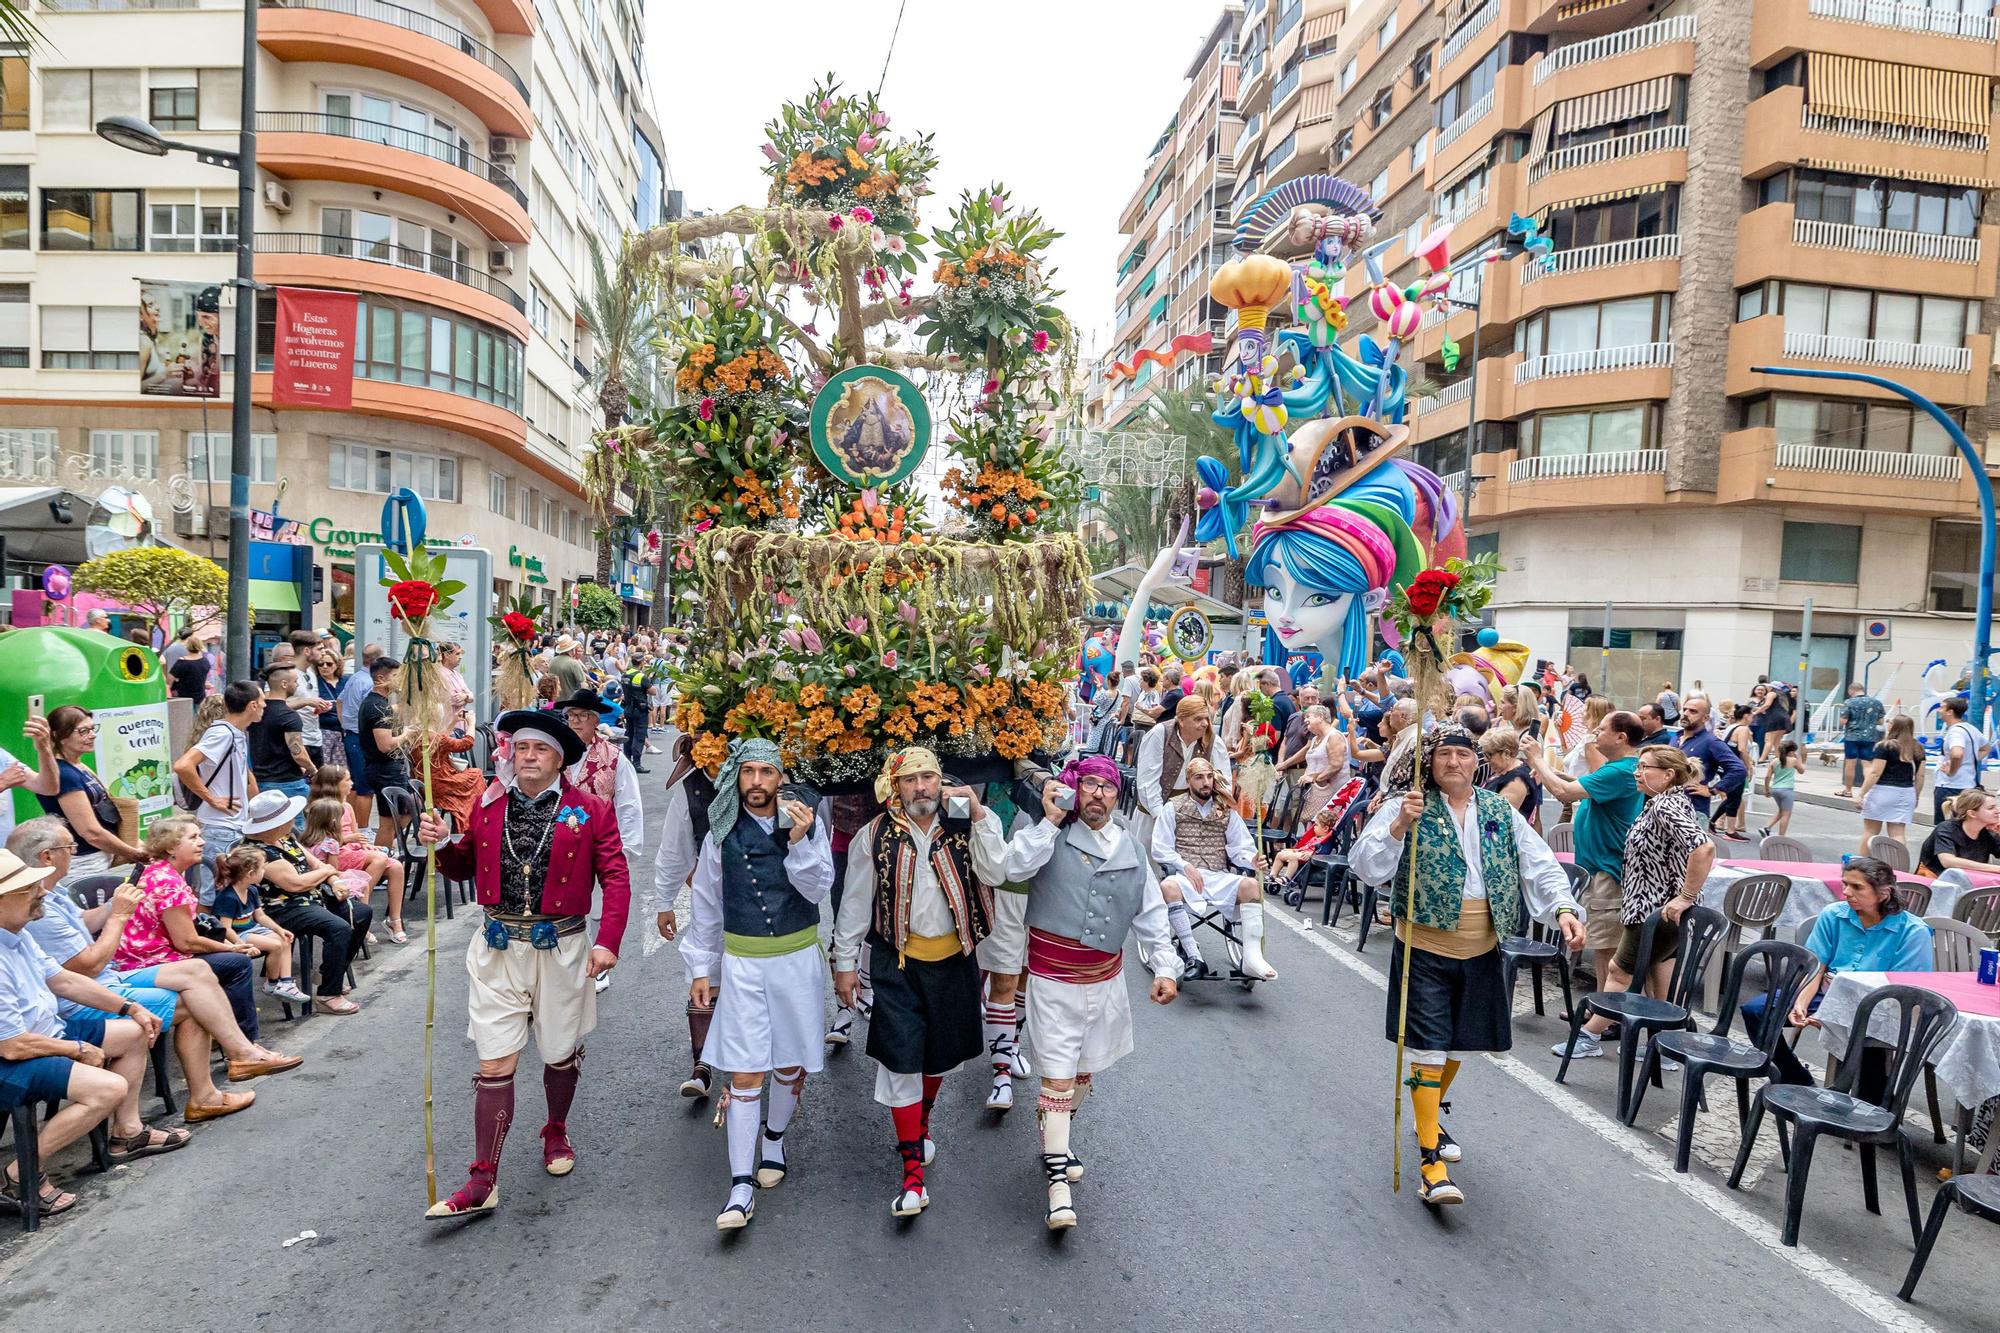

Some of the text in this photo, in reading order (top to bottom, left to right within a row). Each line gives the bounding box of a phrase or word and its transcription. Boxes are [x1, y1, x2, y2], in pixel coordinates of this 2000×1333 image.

[303, 312, 328, 323] Estas
[292, 322, 338, 337] Hogueras
[299, 336, 345, 348] volvemos
[287, 347, 341, 360] a encontrar
[289, 357, 338, 371] en Luceros
[118, 719, 165, 735] Queremos
